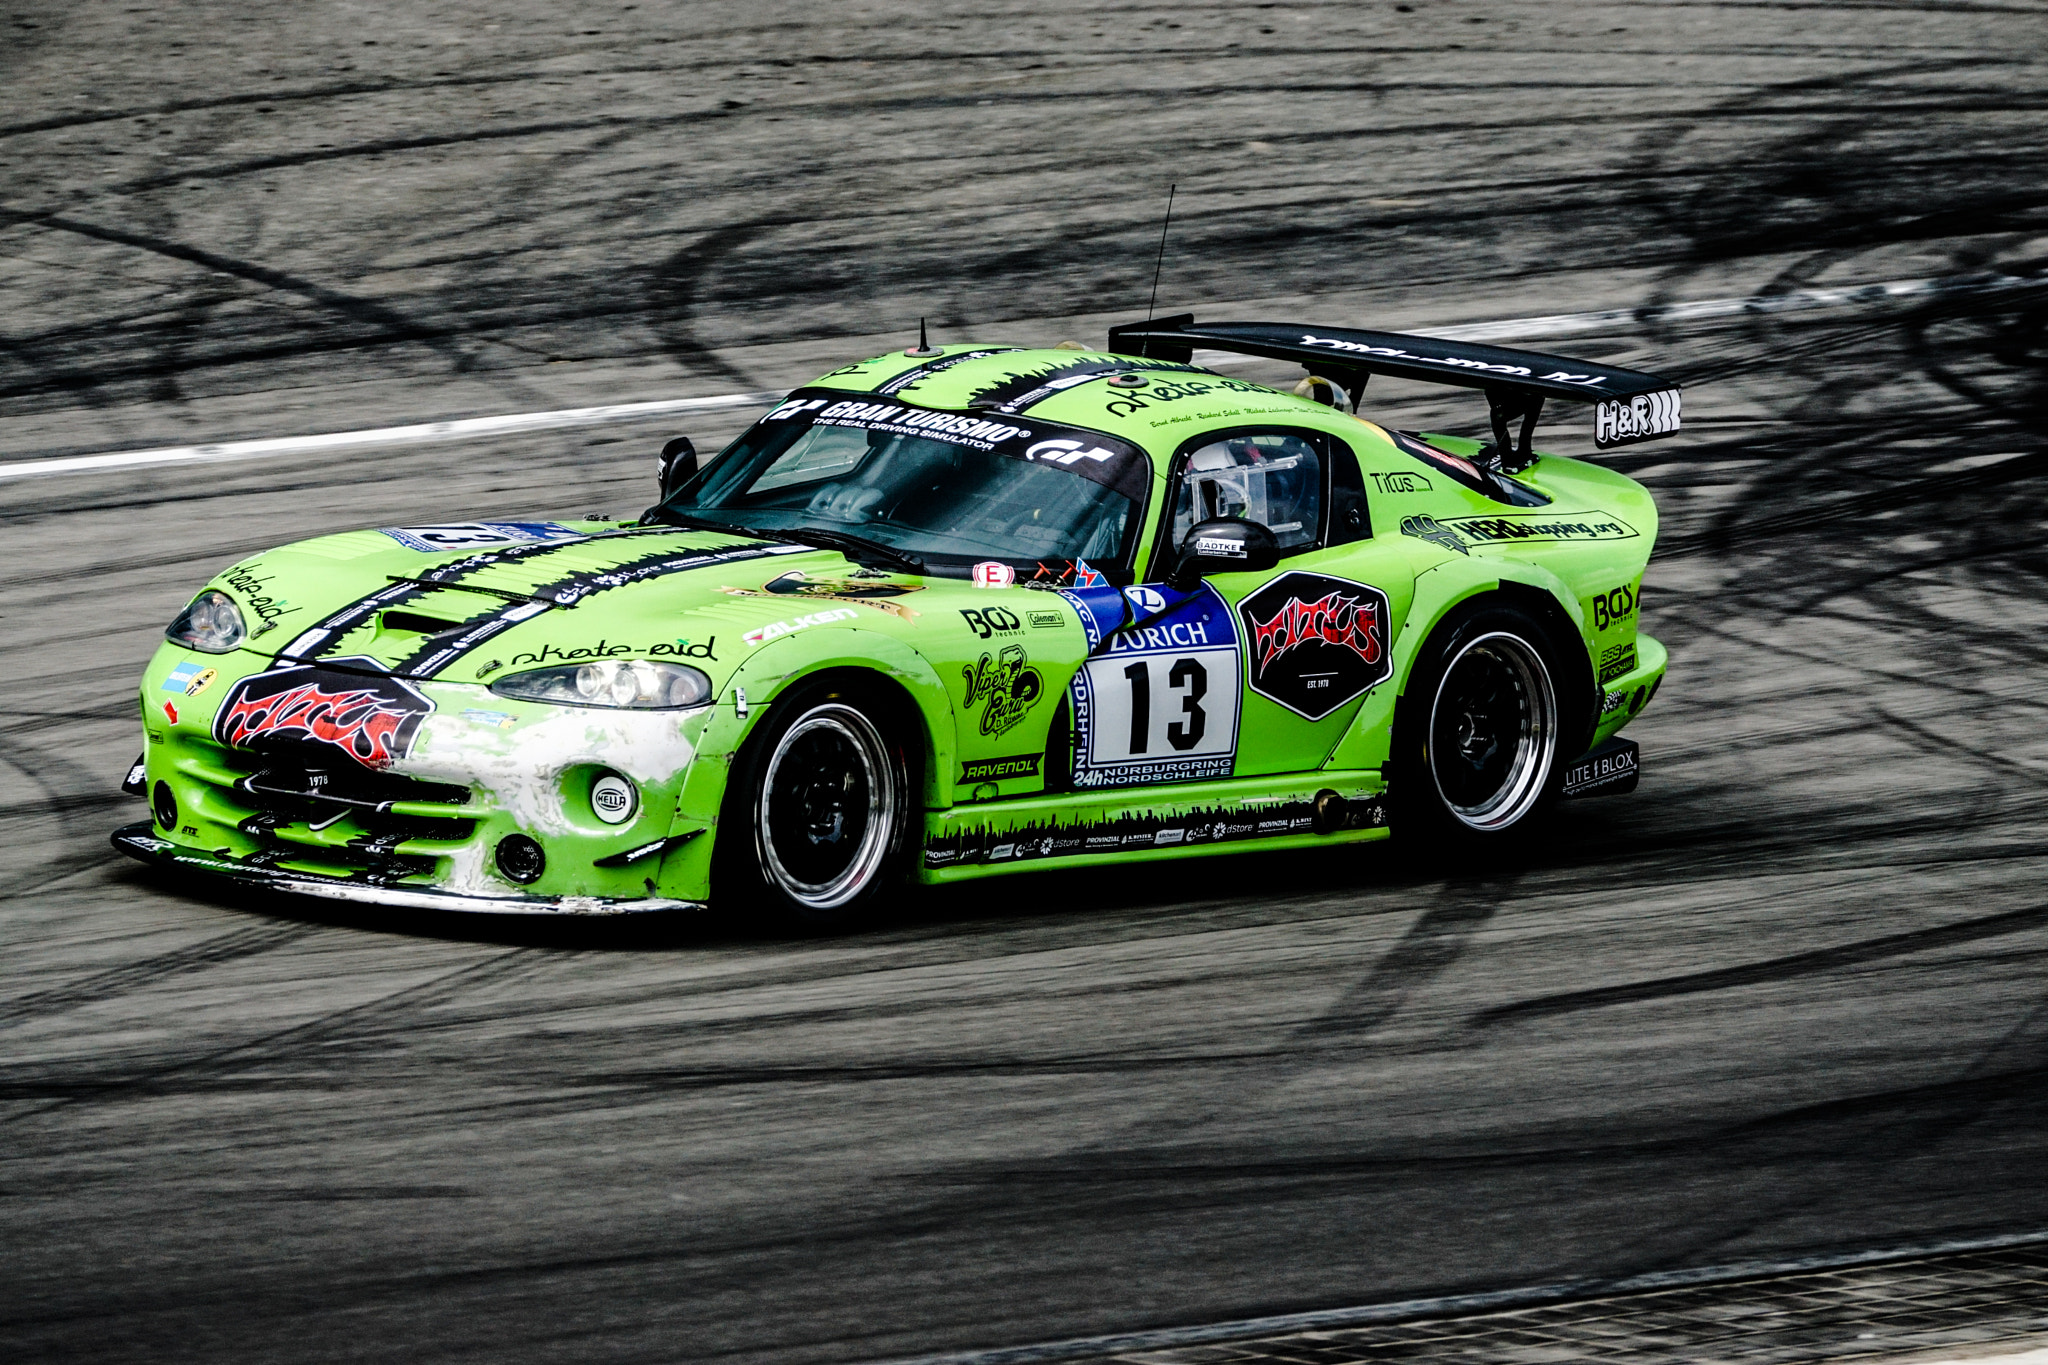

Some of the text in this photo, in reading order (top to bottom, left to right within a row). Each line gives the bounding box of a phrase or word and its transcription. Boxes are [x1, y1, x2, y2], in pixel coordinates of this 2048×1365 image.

[819, 400, 1020, 443] GRAN TURISMO
[1597, 395, 1653, 443] H&R
[812, 417, 994, 452] THE REAL DRIVING SIMULATOR
[1369, 472, 1415, 494] Titus
[1197, 541, 1238, 551] BADTKE
[986, 565, 1001, 583] E
[958, 606, 1021, 640] BGS
[1593, 585, 1634, 632] BGS
[742, 608, 859, 647] FALKEN
[995, 630, 1026, 638] technic
[1110, 621, 1209, 652] ZURICH
[511, 636, 719, 666] skate-aid
[963, 656, 1008, 707] Viper
[1123, 657, 1208, 755] 13
[308, 775, 329, 787] 1978
[966, 760, 1034, 779] RAVENOL
[1073, 759, 1232, 786] 24h NÜRBURGRING
[1103, 767, 1231, 785] NORDSCHLEIFE
[1566, 751, 1634, 786] LITE BLOX
[597, 795, 626, 807] HELLA
[1086, 835, 1120, 844] PROVINZIAL
[1258, 819, 1289, 828] PROVINZIAL
